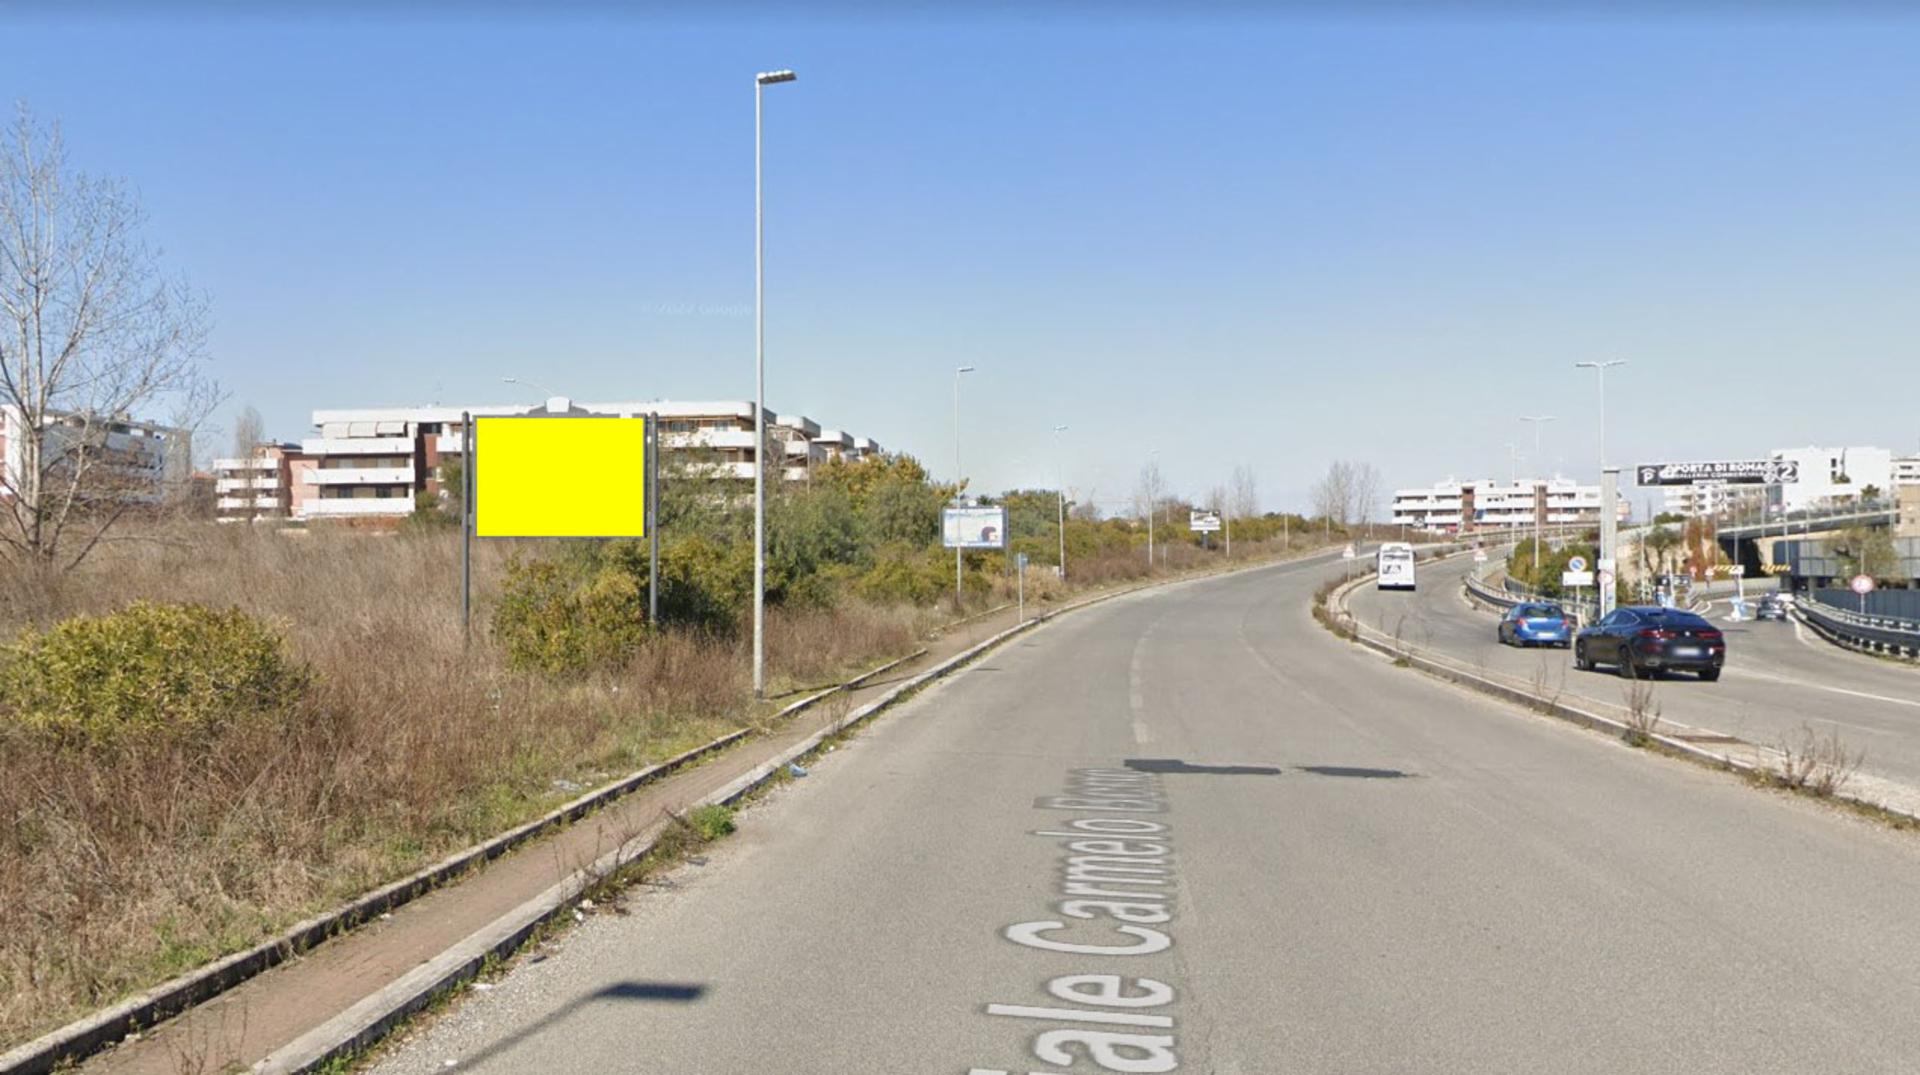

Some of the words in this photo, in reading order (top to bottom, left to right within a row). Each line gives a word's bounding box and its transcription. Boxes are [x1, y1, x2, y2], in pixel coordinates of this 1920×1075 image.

[1676, 463, 1712, 474] PORTA
[1715, 463, 1728, 472] DI
[1729, 461, 1764, 472] ROMA
[1781, 465, 1793, 479] 2
